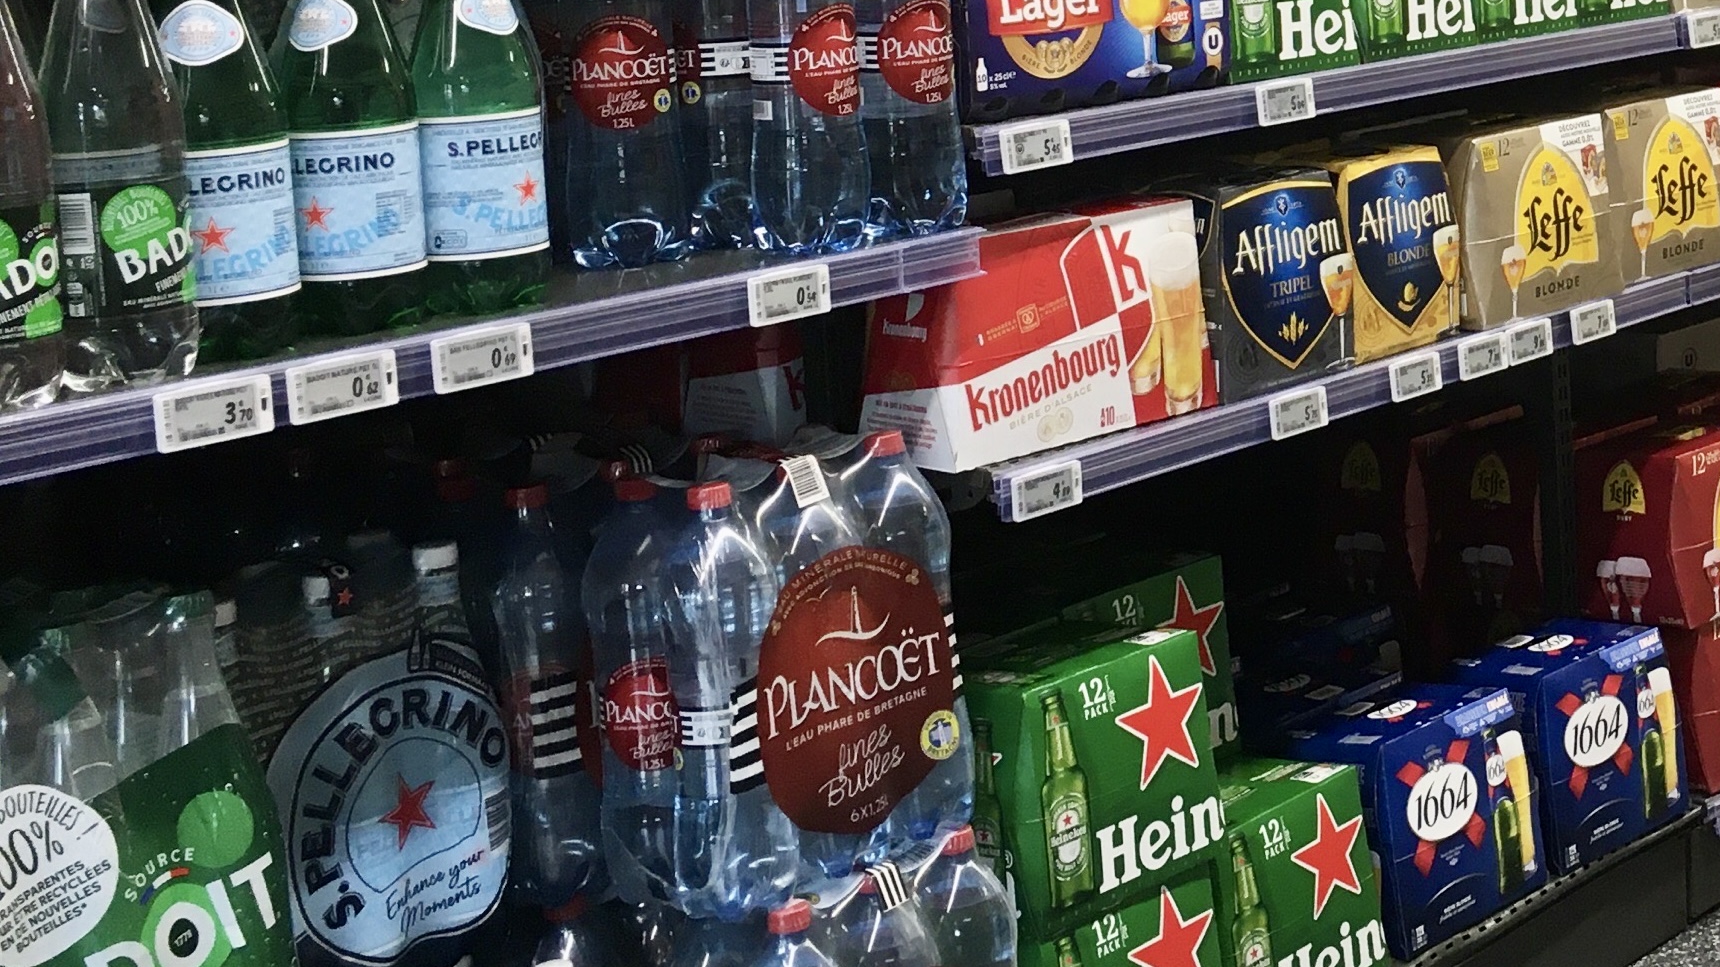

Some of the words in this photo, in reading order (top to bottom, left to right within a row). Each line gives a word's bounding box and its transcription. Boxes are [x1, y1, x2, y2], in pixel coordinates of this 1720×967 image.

[1357, 190, 1452, 246] Affligem
[1652, 154, 1709, 226] Leffe
[1232, 216, 1342, 276] Affligem
[1525, 187, 1585, 261] Leffe
[1662, 238, 1705, 260] BLONDE
[1387, 245, 1432, 268] BLONDE
[1270, 274, 1314, 298] TRIPEL
[1535, 274, 1581, 298] BLONDE
[965, 332, 1121, 434] Kronenbourg
[763, 626, 940, 740] PLANCOËT
[1078, 677, 1106, 710] 12
[1084, 700, 1109, 721] PACK
[816, 717, 853, 739] PHARE
[855, 711, 868, 724] DE
[870, 686, 927, 717] BRETAGNE
[1570, 702, 1622, 759] 1664
[818, 748, 906, 808] Bulles
[835, 724, 892, 777] fines
[301, 689, 507, 932] S.PELLEGRINO
[1414, 772, 1473, 831] 1664
[125, 846, 196, 904] SOURCE
[27, 881, 103, 928] NOUVELLES
[400, 879, 482, 938] Moments
